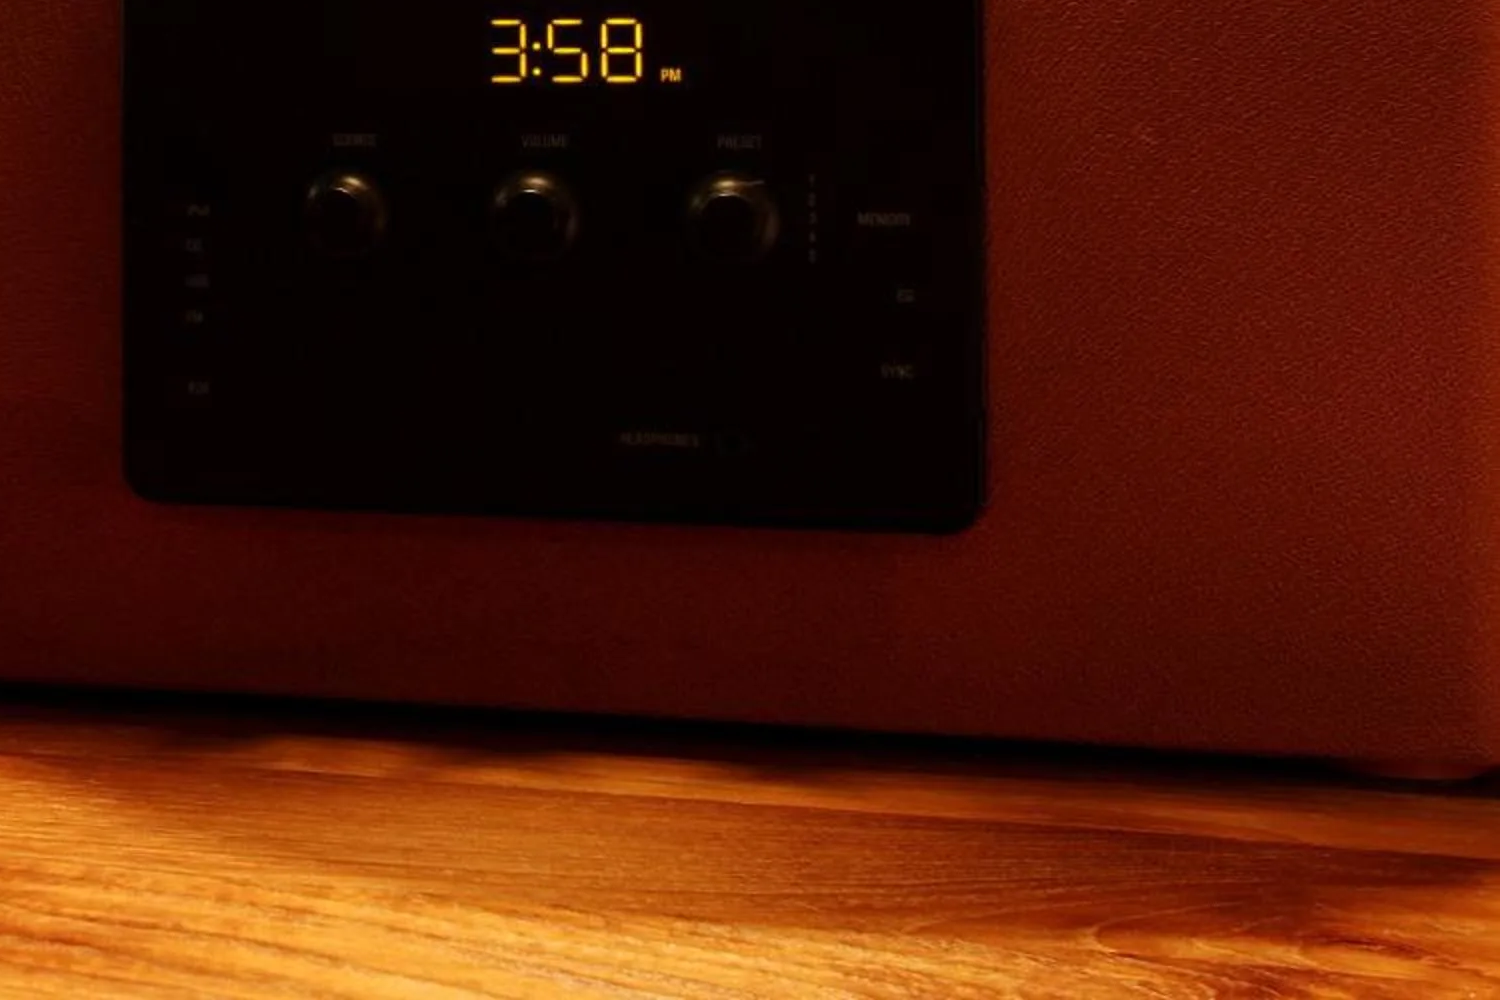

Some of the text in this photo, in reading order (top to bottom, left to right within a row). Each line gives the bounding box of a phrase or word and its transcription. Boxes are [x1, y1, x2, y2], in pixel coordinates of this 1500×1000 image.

[490, 17, 682, 83] 3:58 PM
[520, 133, 569, 148] VOLUME
